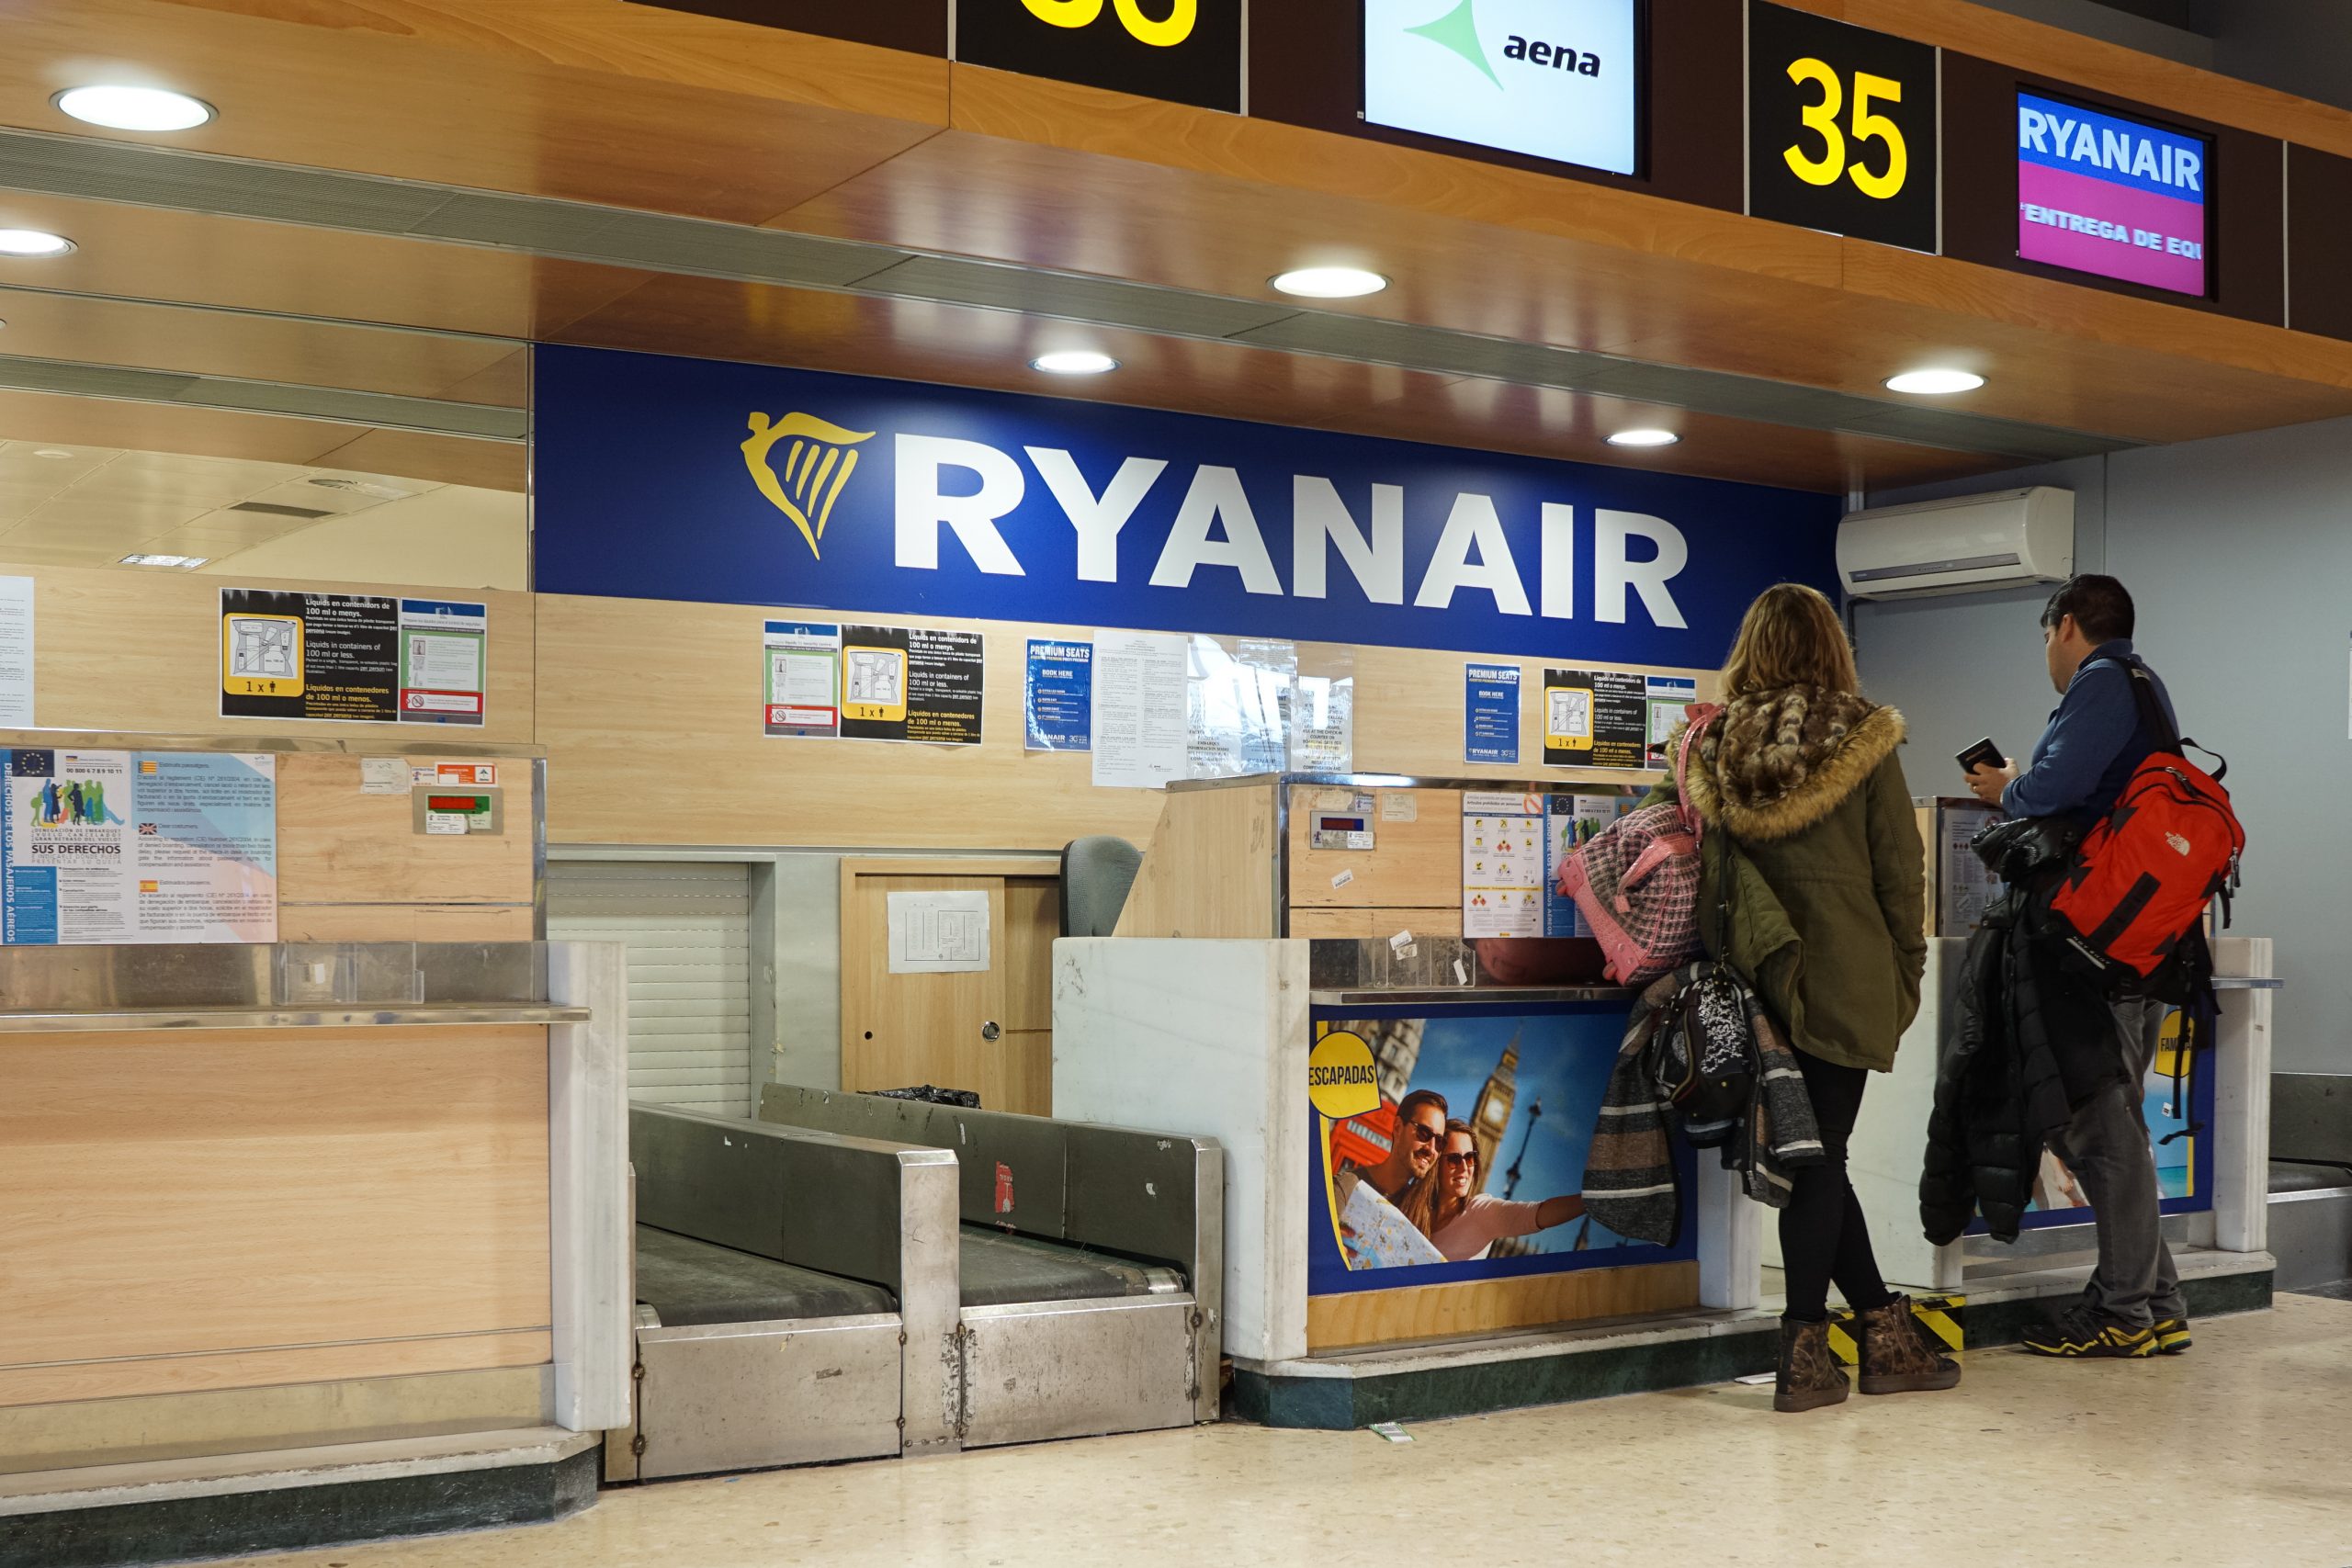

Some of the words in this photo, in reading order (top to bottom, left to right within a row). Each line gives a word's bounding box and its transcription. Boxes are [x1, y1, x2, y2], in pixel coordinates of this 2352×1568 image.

[1503, 35, 1600, 77] aena
[1783, 58, 1907, 198] 35
[2019, 107, 2200, 191] RYANAIR
[2133, 229, 2163, 251] DE
[895, 434, 1689, 630] RYANAIR
[342, 601, 379, 609] contenidors
[339, 642, 372, 650] containers
[938, 636, 968, 644] contenidors
[1030, 645, 1065, 656] PREMIUM
[1066, 647, 1090, 658] SEATS
[935, 672, 962, 681] containers
[1469, 669, 1497, 679] PREMIUM
[1498, 670, 1517, 681] SEATS
[245, 681, 253, 692] 1
[257, 683, 264, 693] x
[860, 706, 865, 716] 1
[1559, 738, 1563, 747] 1
[6, 815, 12, 827] DE
[31, 845, 54, 854] SUS
[58, 845, 121, 854] DERECHOS
[6, 851, 15, 903] PASAJEROS
[1308, 1065, 1374, 1086] ESCAPADAS
